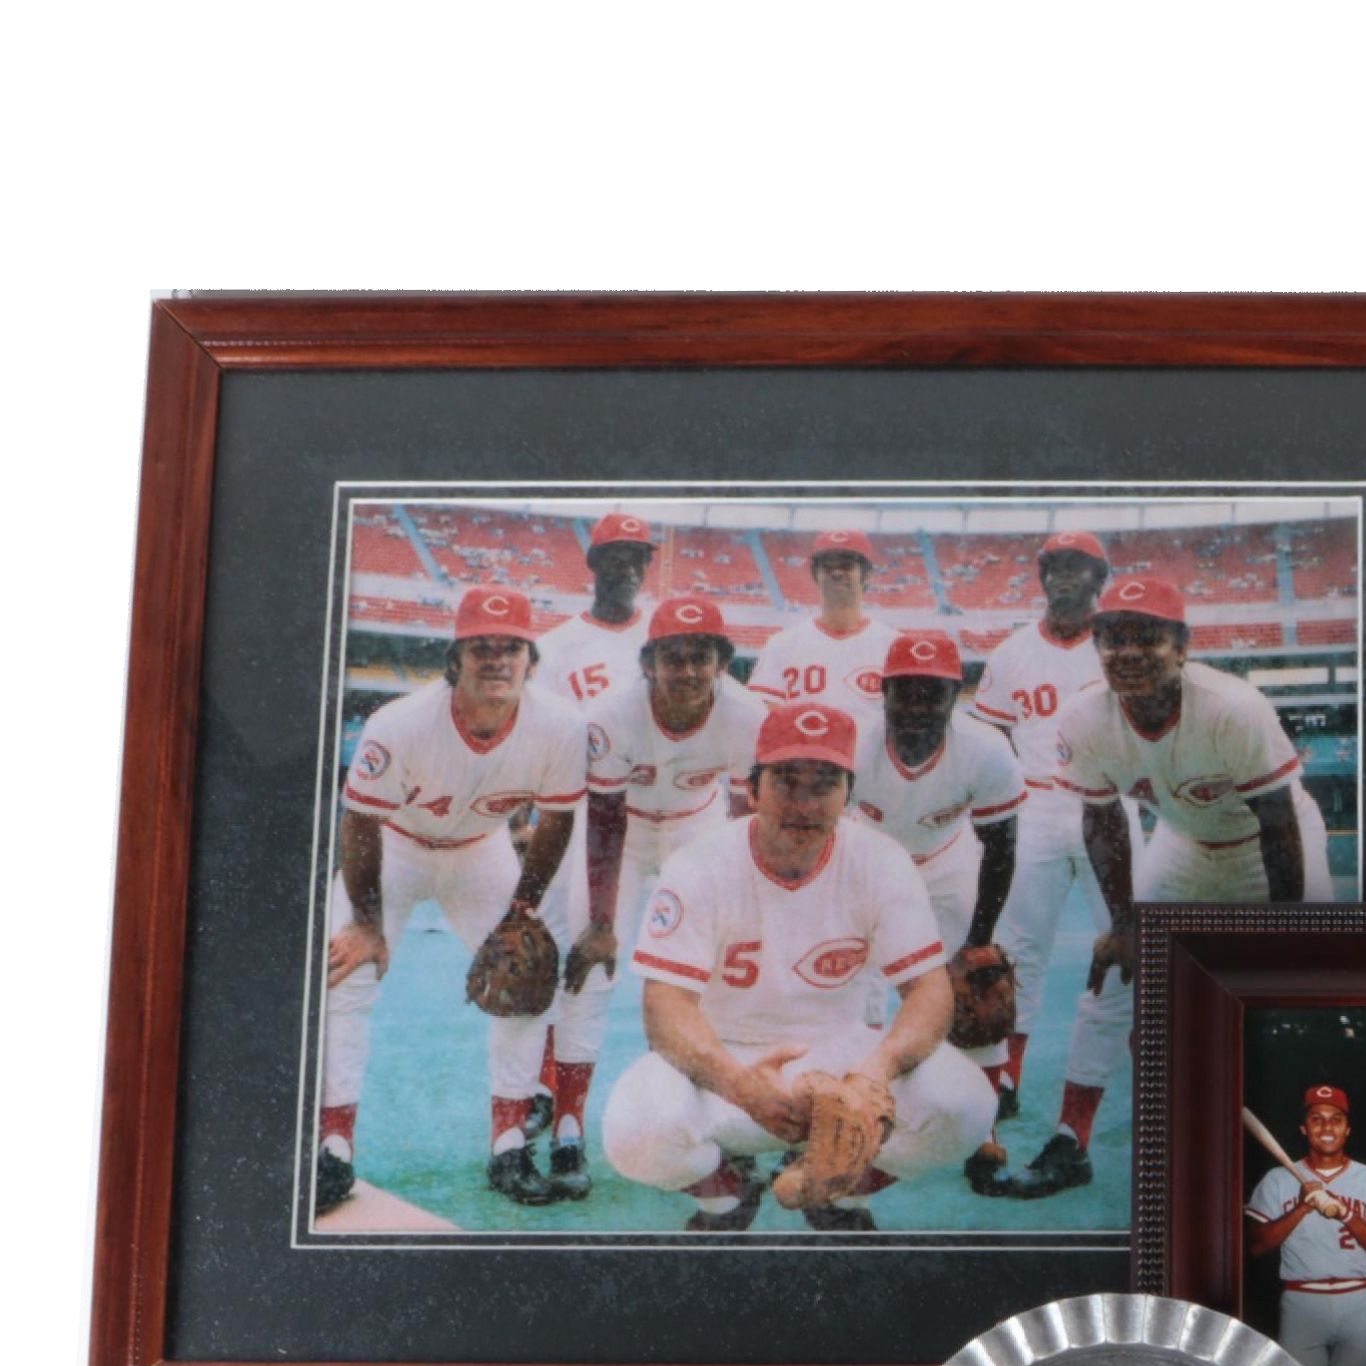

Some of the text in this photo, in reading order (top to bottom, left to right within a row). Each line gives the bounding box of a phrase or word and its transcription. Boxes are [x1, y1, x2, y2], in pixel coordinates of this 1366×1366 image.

[567, 664, 609, 700] 15
[1013, 683, 1058, 720] 30
[722, 941, 762, 988] 5
